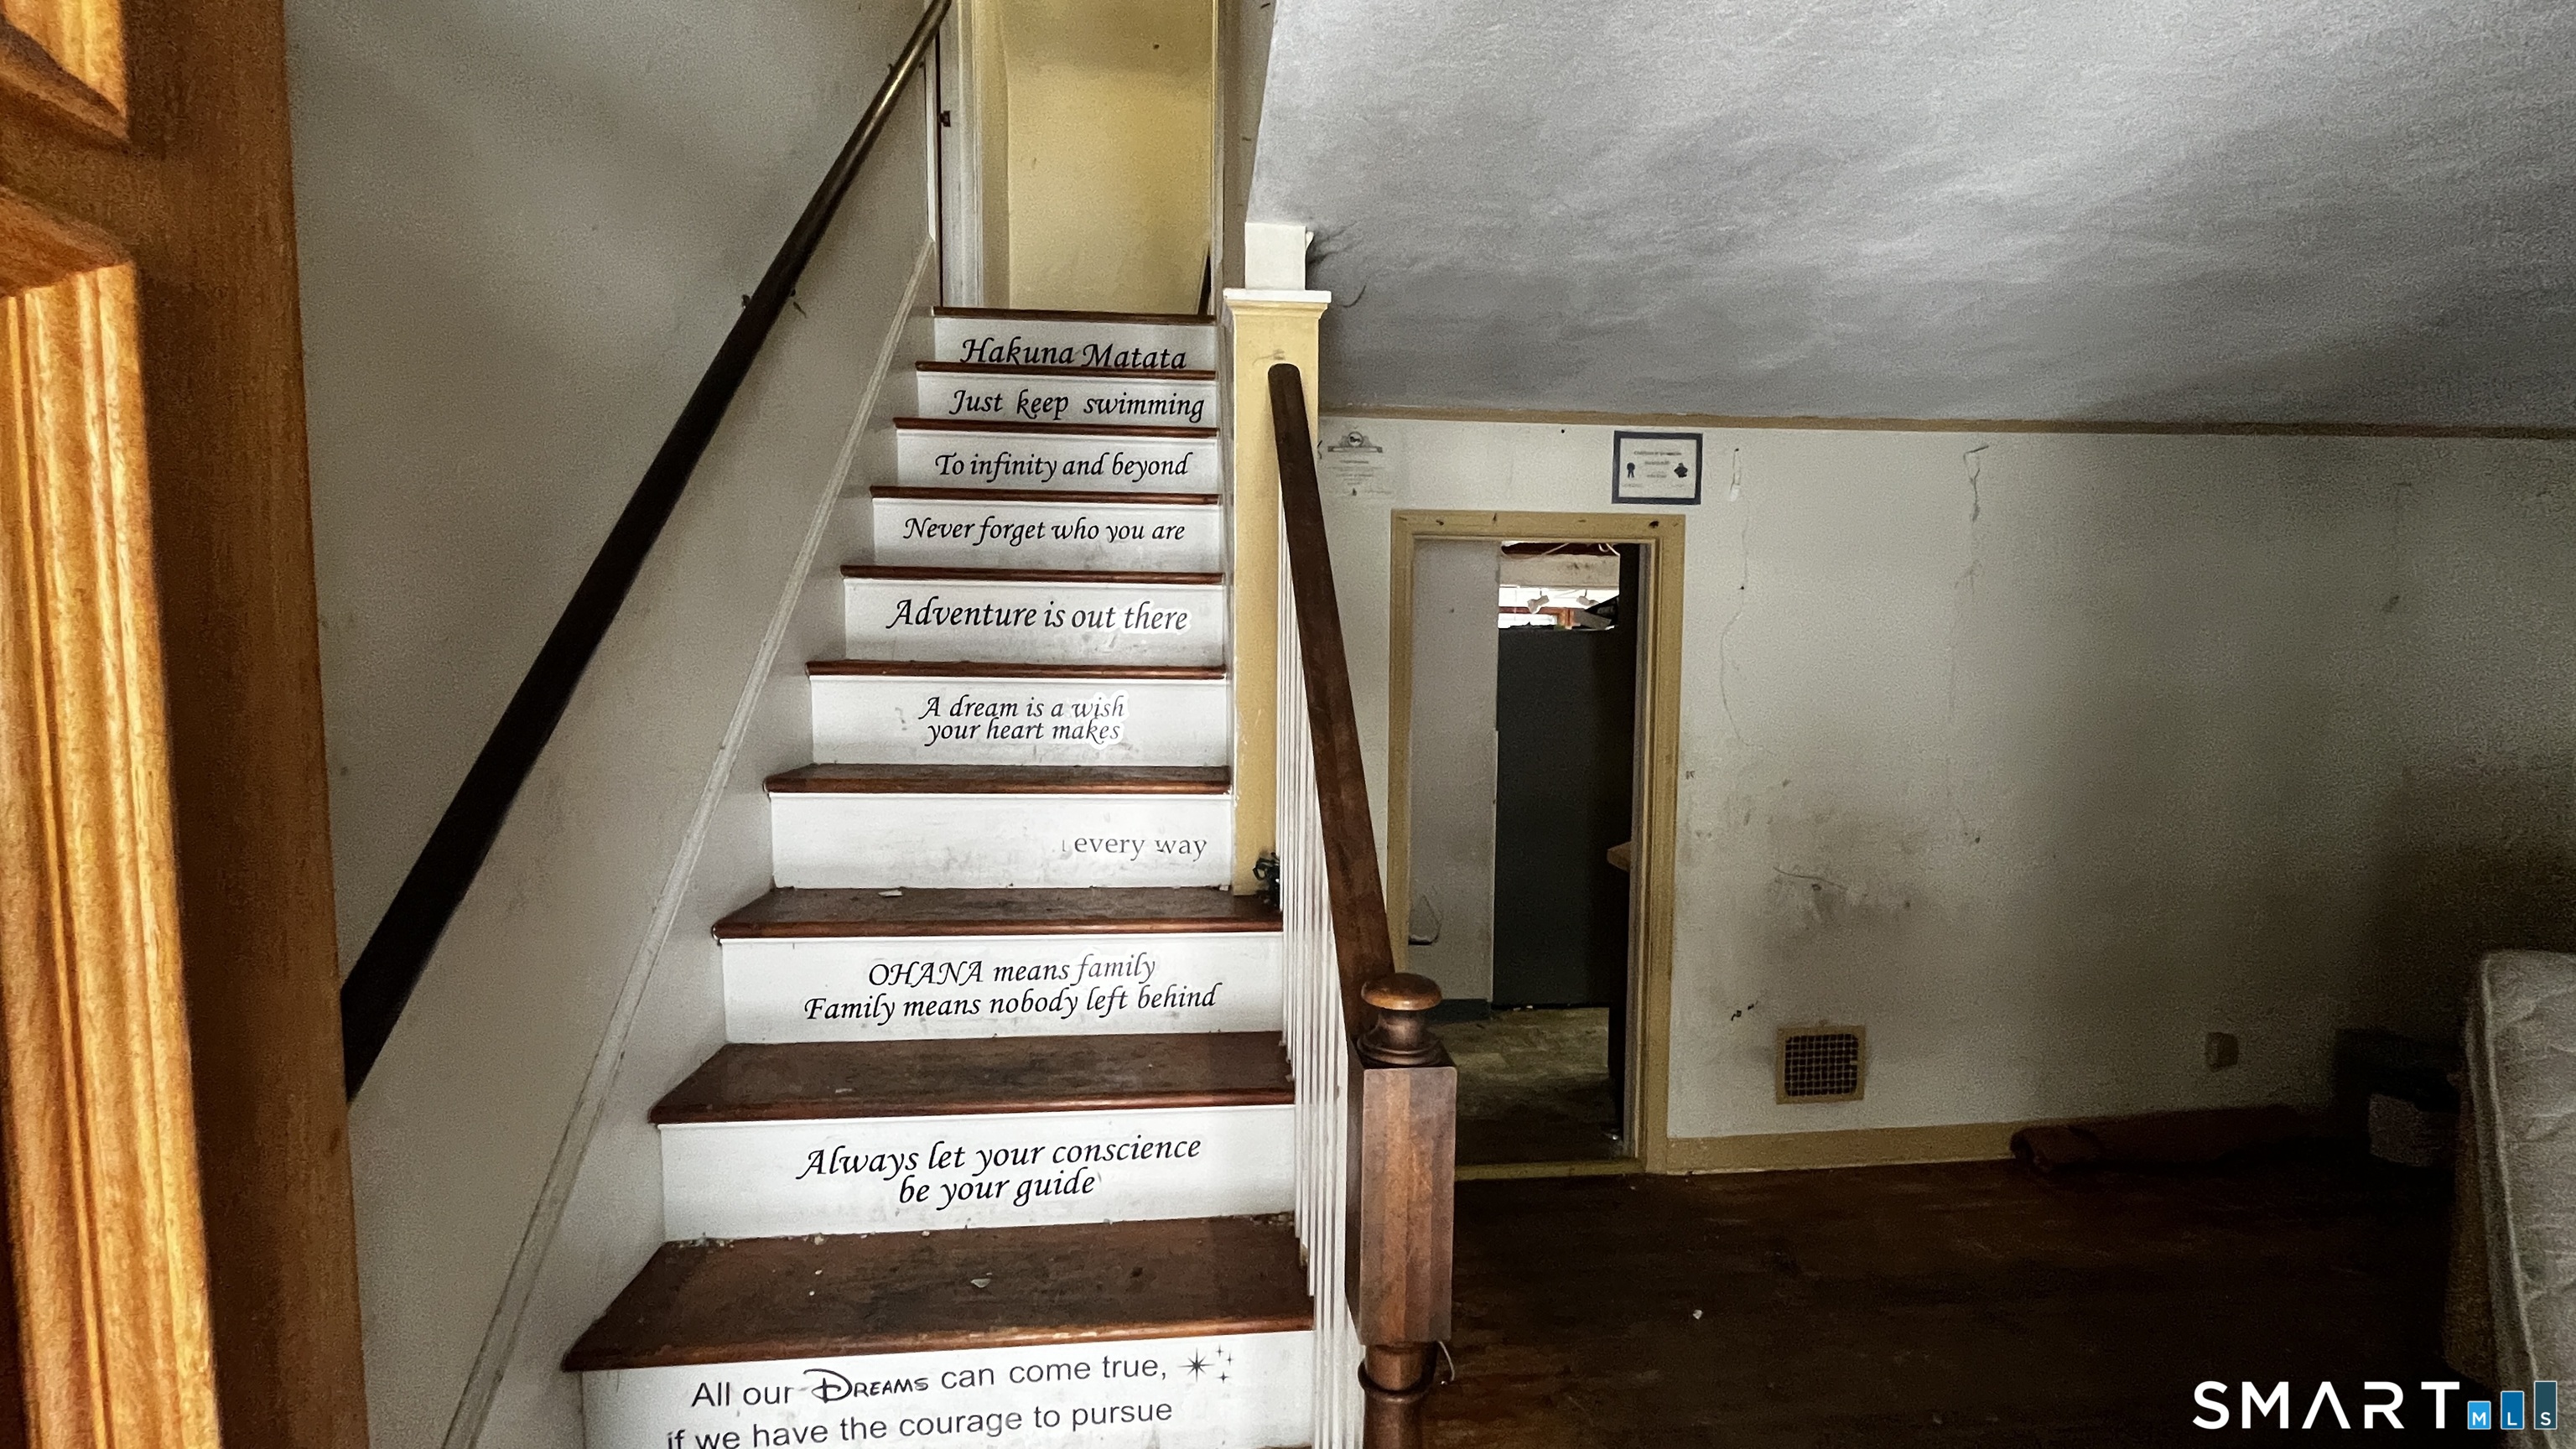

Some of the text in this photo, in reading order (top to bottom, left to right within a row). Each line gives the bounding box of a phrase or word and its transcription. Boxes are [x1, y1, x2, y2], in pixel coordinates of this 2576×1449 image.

[959, 336, 1187, 369] Hakuna Matata
[948, 389, 1205, 423] Just keep swimming
[935, 452, 1193, 482] To infinity and beyond
[903, 516, 1185, 546] Never forget who you are
[886, 596, 1188, 631] Adventure is out there
[918, 694, 1125, 719] A dream is a wish
[924, 718, 1121, 747] your heart makes
[1074, 838, 1145, 861] every
[1154, 839, 1208, 862] way
[869, 952, 1156, 988] OHANA means family
[803, 982, 1223, 1026] Family means nobody left behind
[796, 1135, 1202, 1180] Always let your conscience
[899, 1167, 1096, 1210] be your guide
[691, 1382, 730, 1407] All
[743, 1386, 794, 1405] our
[941, 1367, 995, 1389] can
[1009, 1359, 1091, 1384] come
[1102, 1355, 1167, 1381] true,
[667, 1402, 1173, 1449] if we have the courage to pursue
